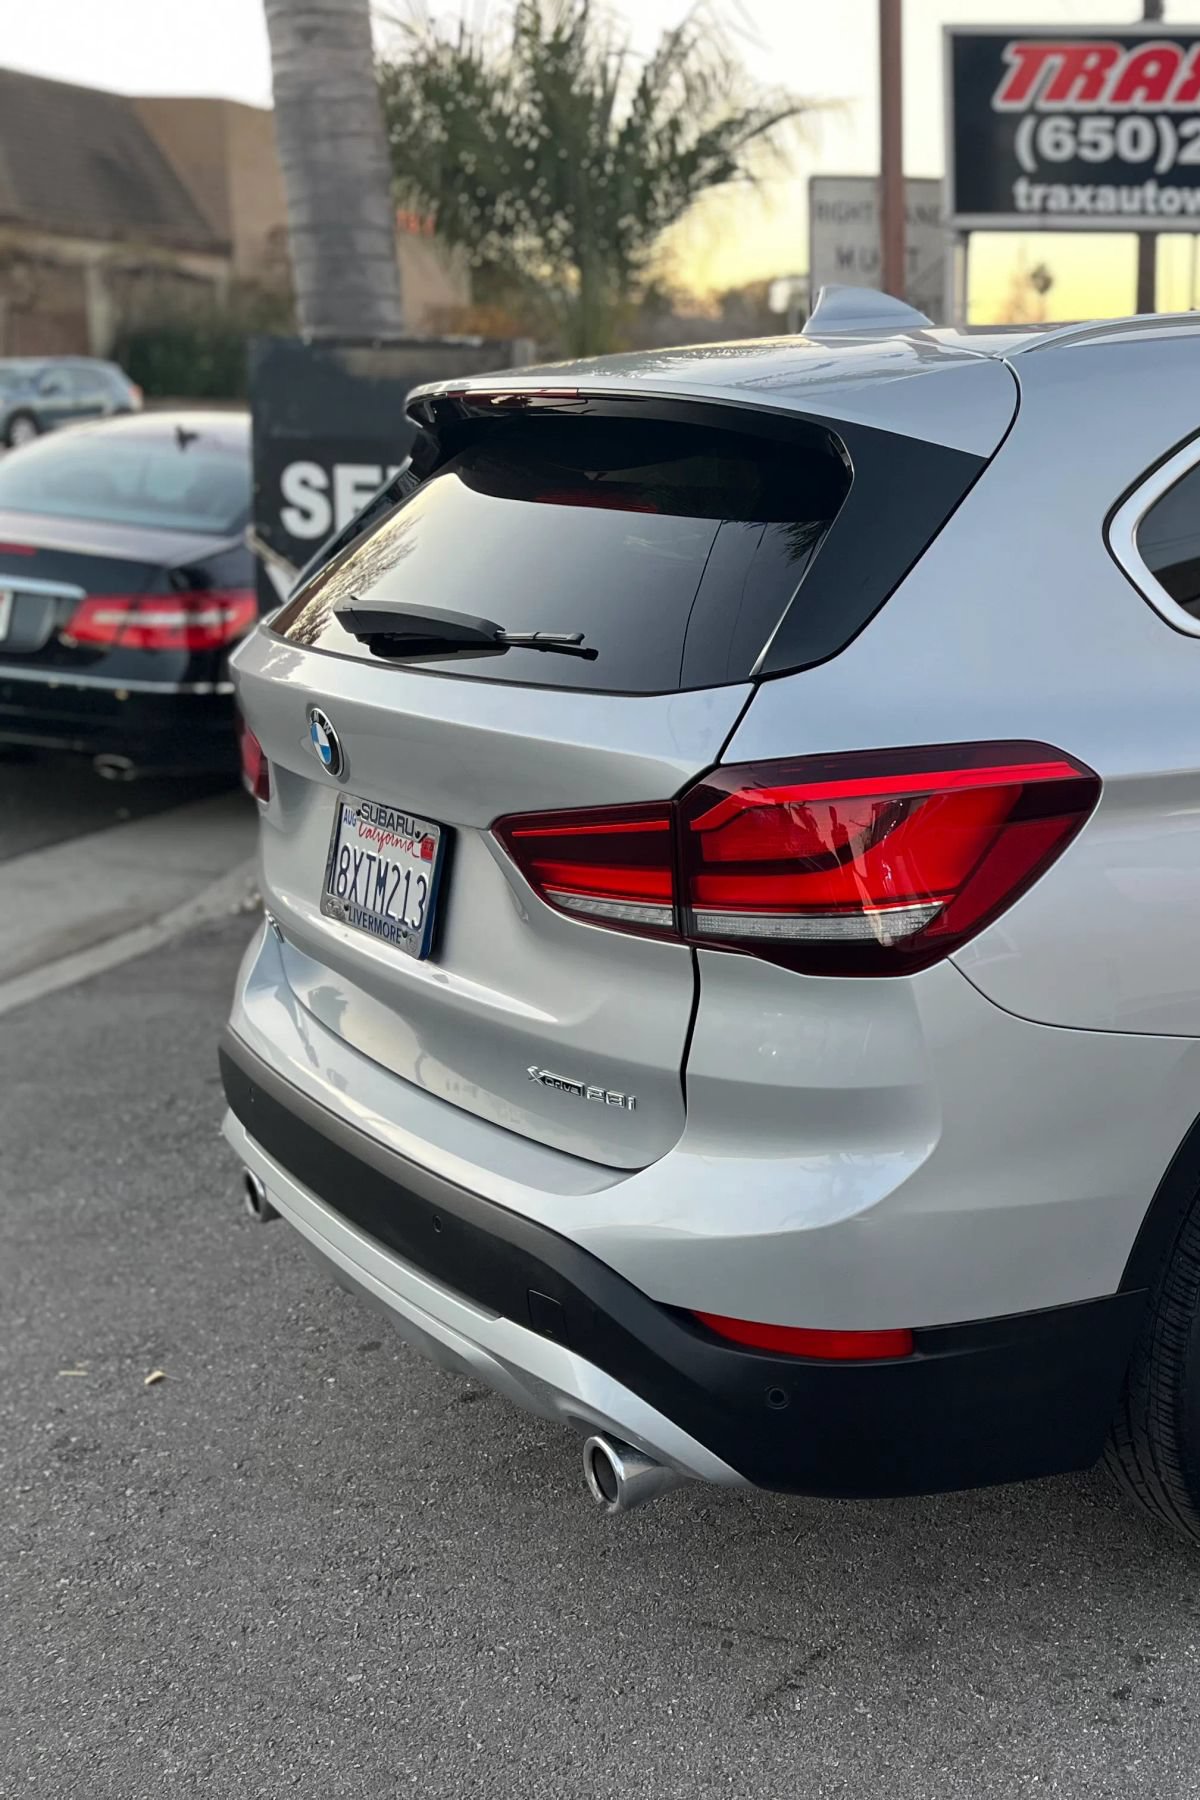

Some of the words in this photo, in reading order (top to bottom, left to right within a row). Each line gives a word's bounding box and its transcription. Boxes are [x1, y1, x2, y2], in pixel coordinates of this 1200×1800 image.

[835, 245, 920, 273] MUT
[280, 459, 400, 540] SE
[343, 808, 357, 827] AUG
[361, 802, 415, 837] SUBARU
[337, 844, 427, 930] 8XTM213
[348, 905, 402, 945] LIVERMORE
